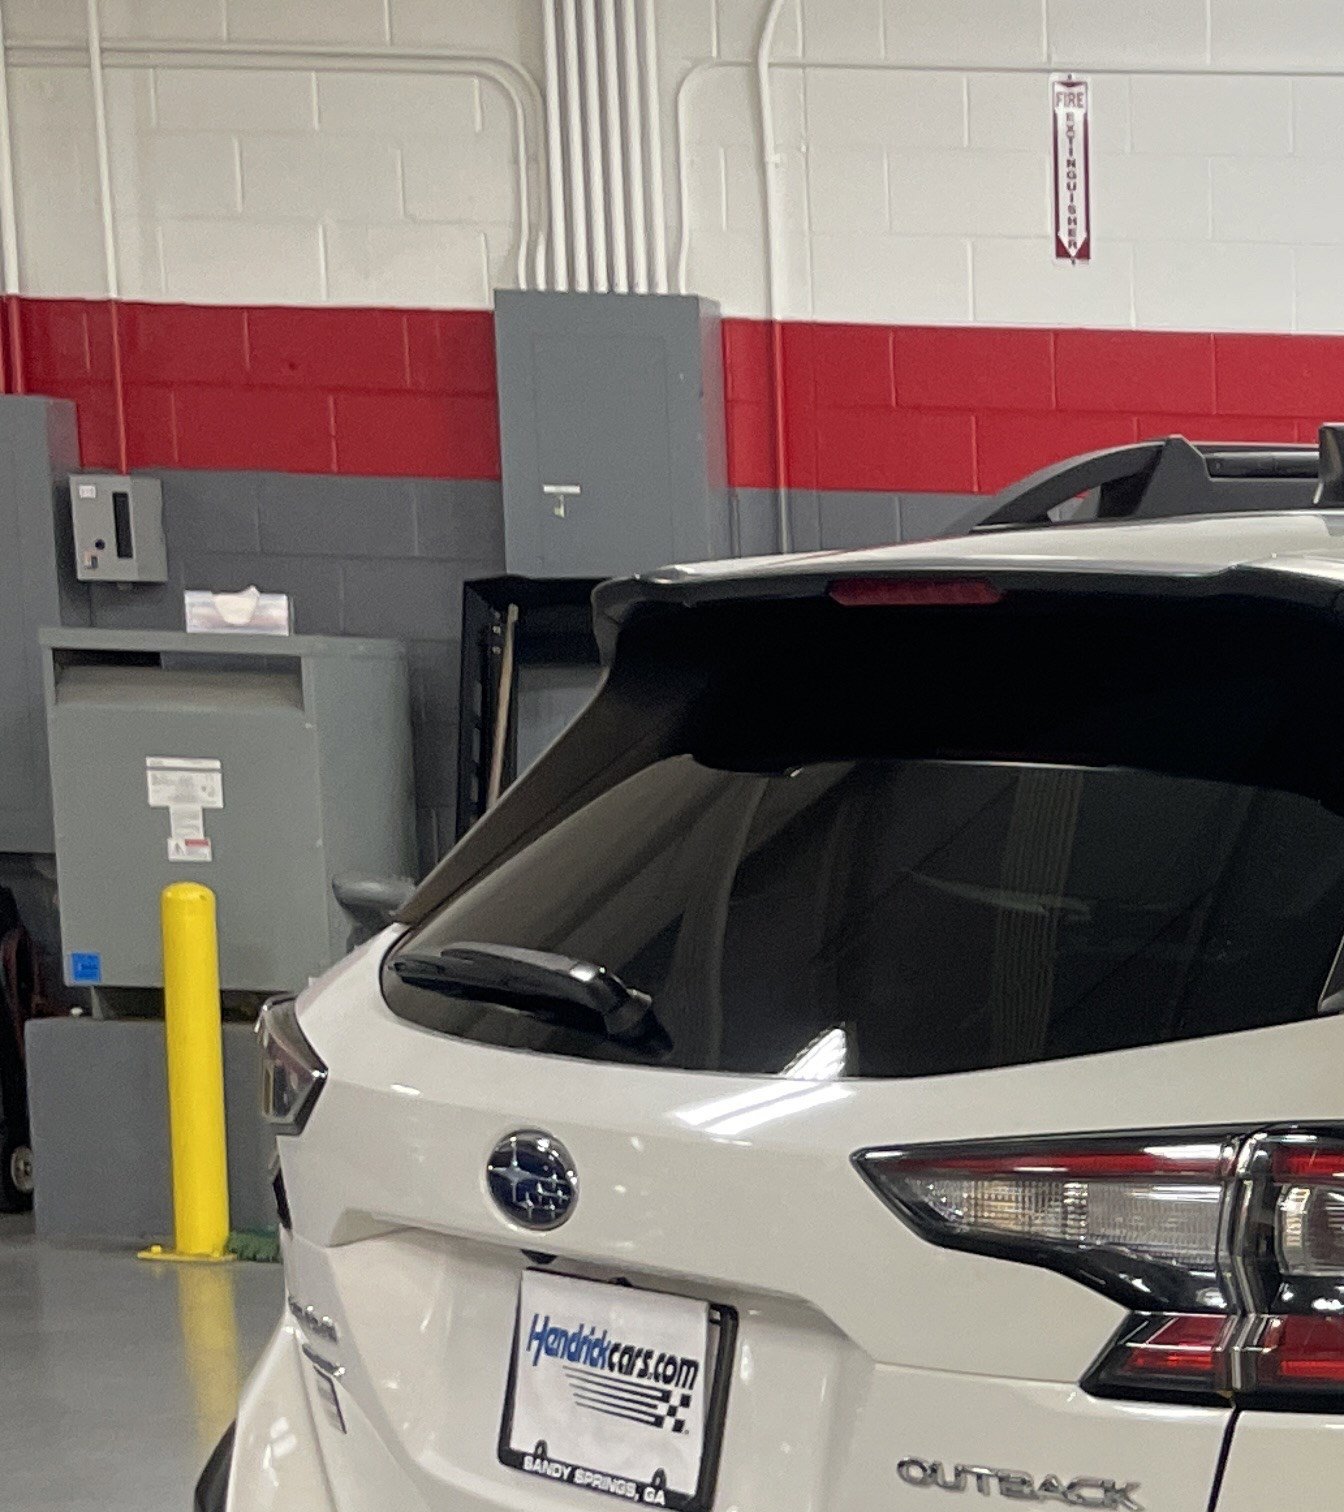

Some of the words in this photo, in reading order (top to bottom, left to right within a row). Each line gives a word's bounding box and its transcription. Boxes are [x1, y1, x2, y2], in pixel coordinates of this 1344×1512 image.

[1055, 92, 1084, 108] FIRE
[1065, 111, 1078, 249] EXTINGUISHER
[526, 1313, 699, 1390] Hendrickcars.com
[523, 1455, 572, 1480] SANDY
[573, 1468, 639, 1501] SPRINGS,
[643, 1486, 666, 1506] GA
[896, 1456, 1146, 1512] OUTBACK
